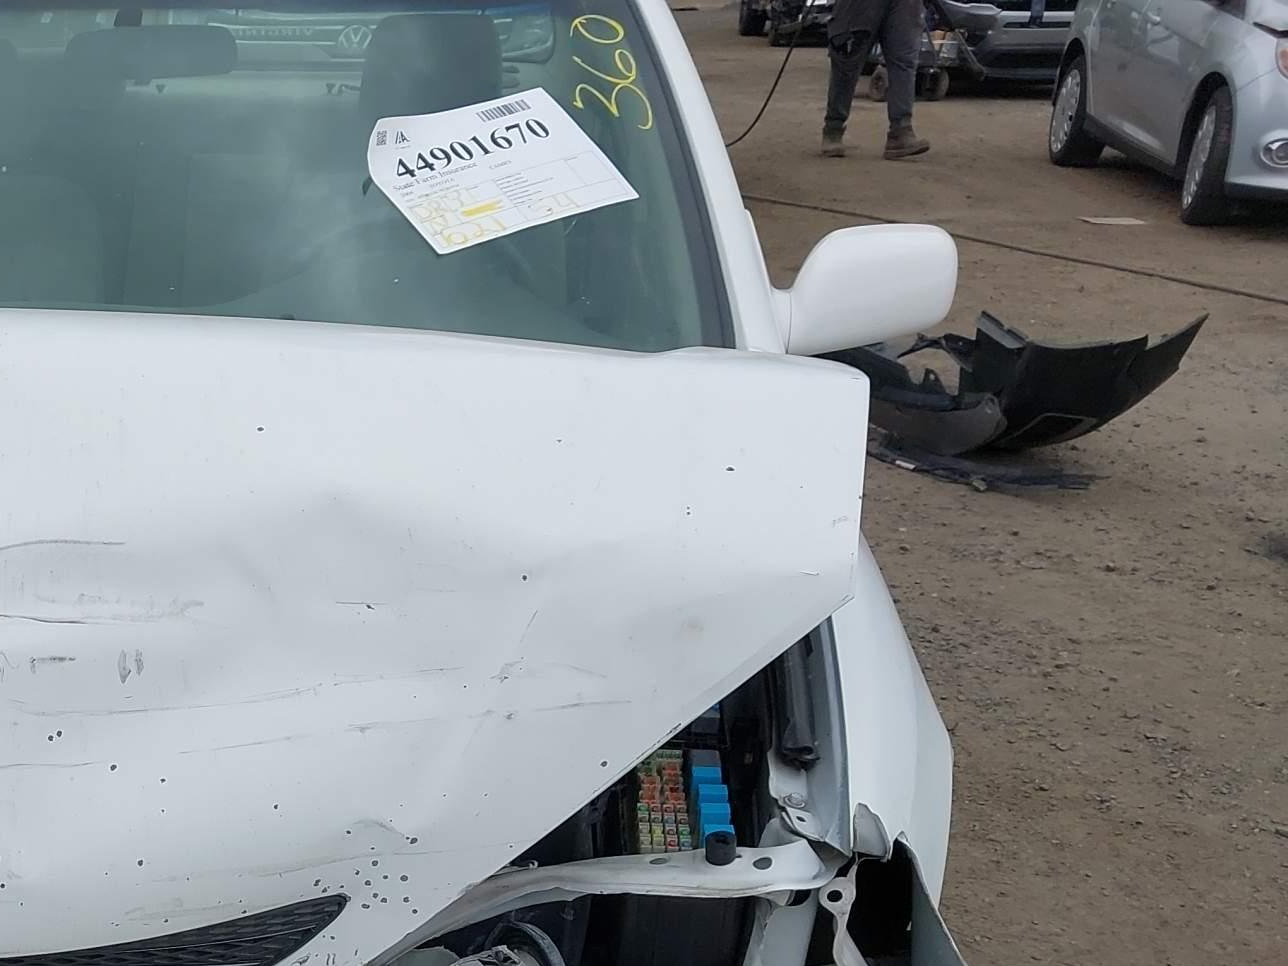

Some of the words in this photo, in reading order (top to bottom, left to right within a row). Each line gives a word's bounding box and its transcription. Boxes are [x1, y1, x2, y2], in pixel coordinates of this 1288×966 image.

[570, 15, 653, 130] 360
[396, 118, 550, 178] 44901670
[439, 162, 478, 177] Insurance
